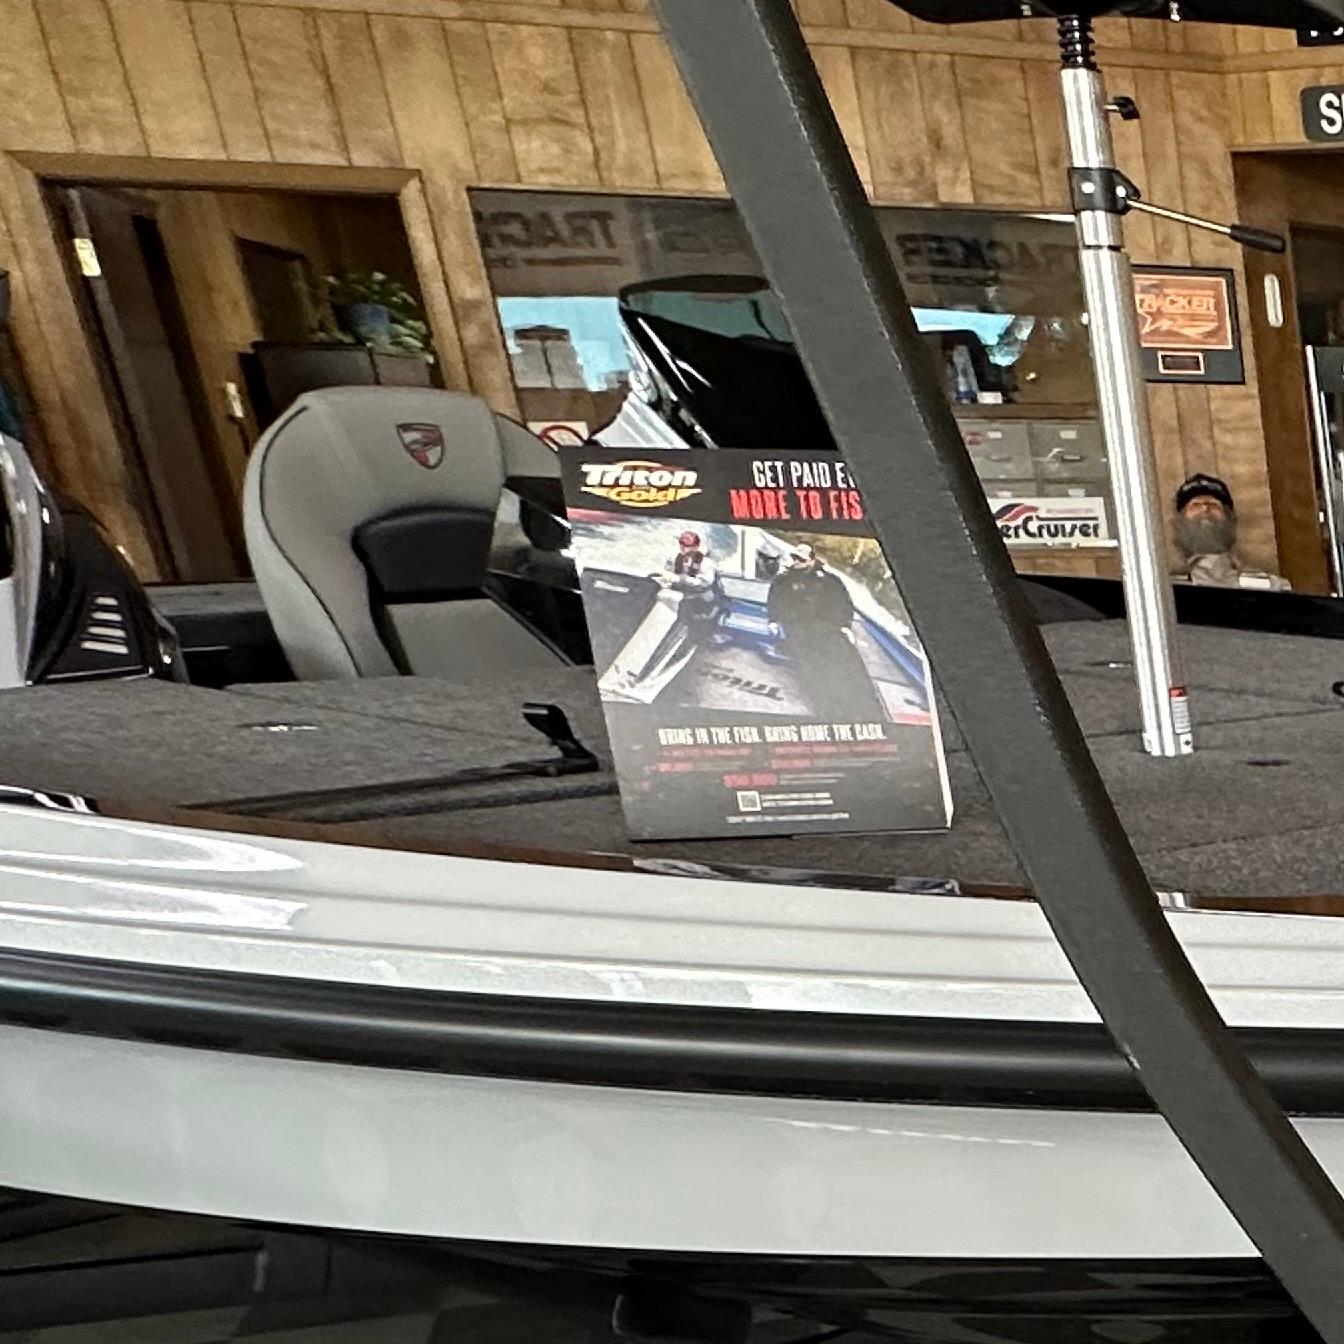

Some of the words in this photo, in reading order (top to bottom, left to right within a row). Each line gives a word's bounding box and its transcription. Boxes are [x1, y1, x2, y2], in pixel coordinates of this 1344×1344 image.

[752, 461, 784, 488] GET
[790, 460, 832, 488] PAID
[729, 489, 791, 520] MORE
[796, 490, 823, 520] TO
[828, 489, 865, 520] FIS
